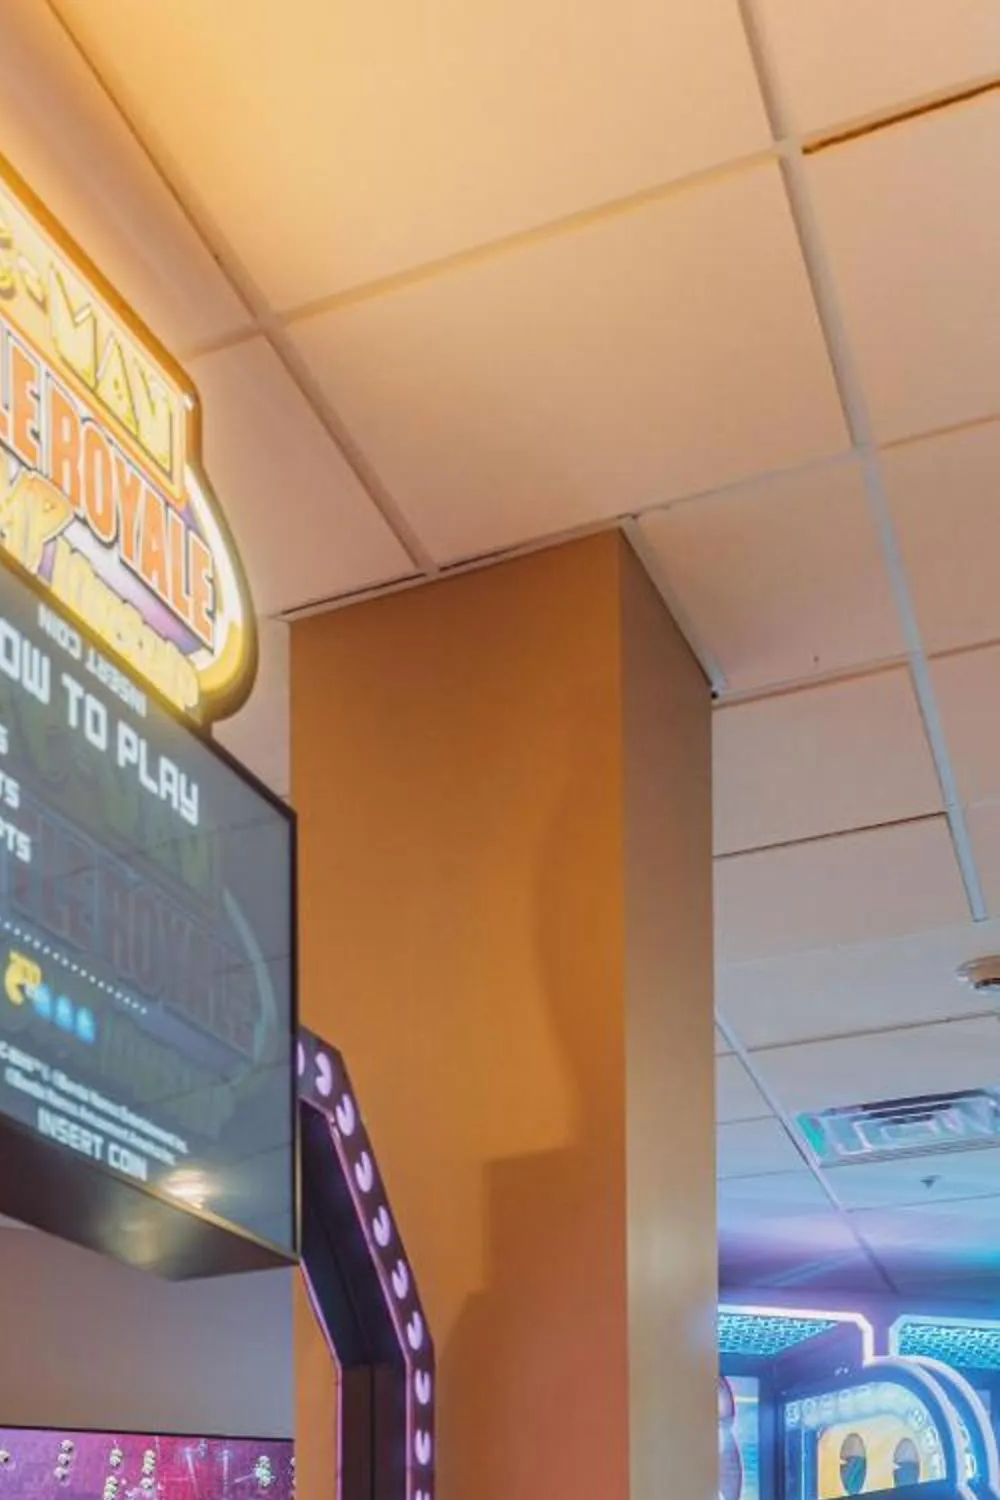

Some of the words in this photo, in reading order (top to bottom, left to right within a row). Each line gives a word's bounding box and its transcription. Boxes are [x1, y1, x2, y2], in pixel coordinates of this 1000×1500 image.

[44, 369, 215, 653] ROYALE
[62, 672, 107, 751] TO
[117, 720, 199, 826] PLAY
[37, 1106, 104, 1160] INSERT
[108, 1142, 148, 1182] COIN
